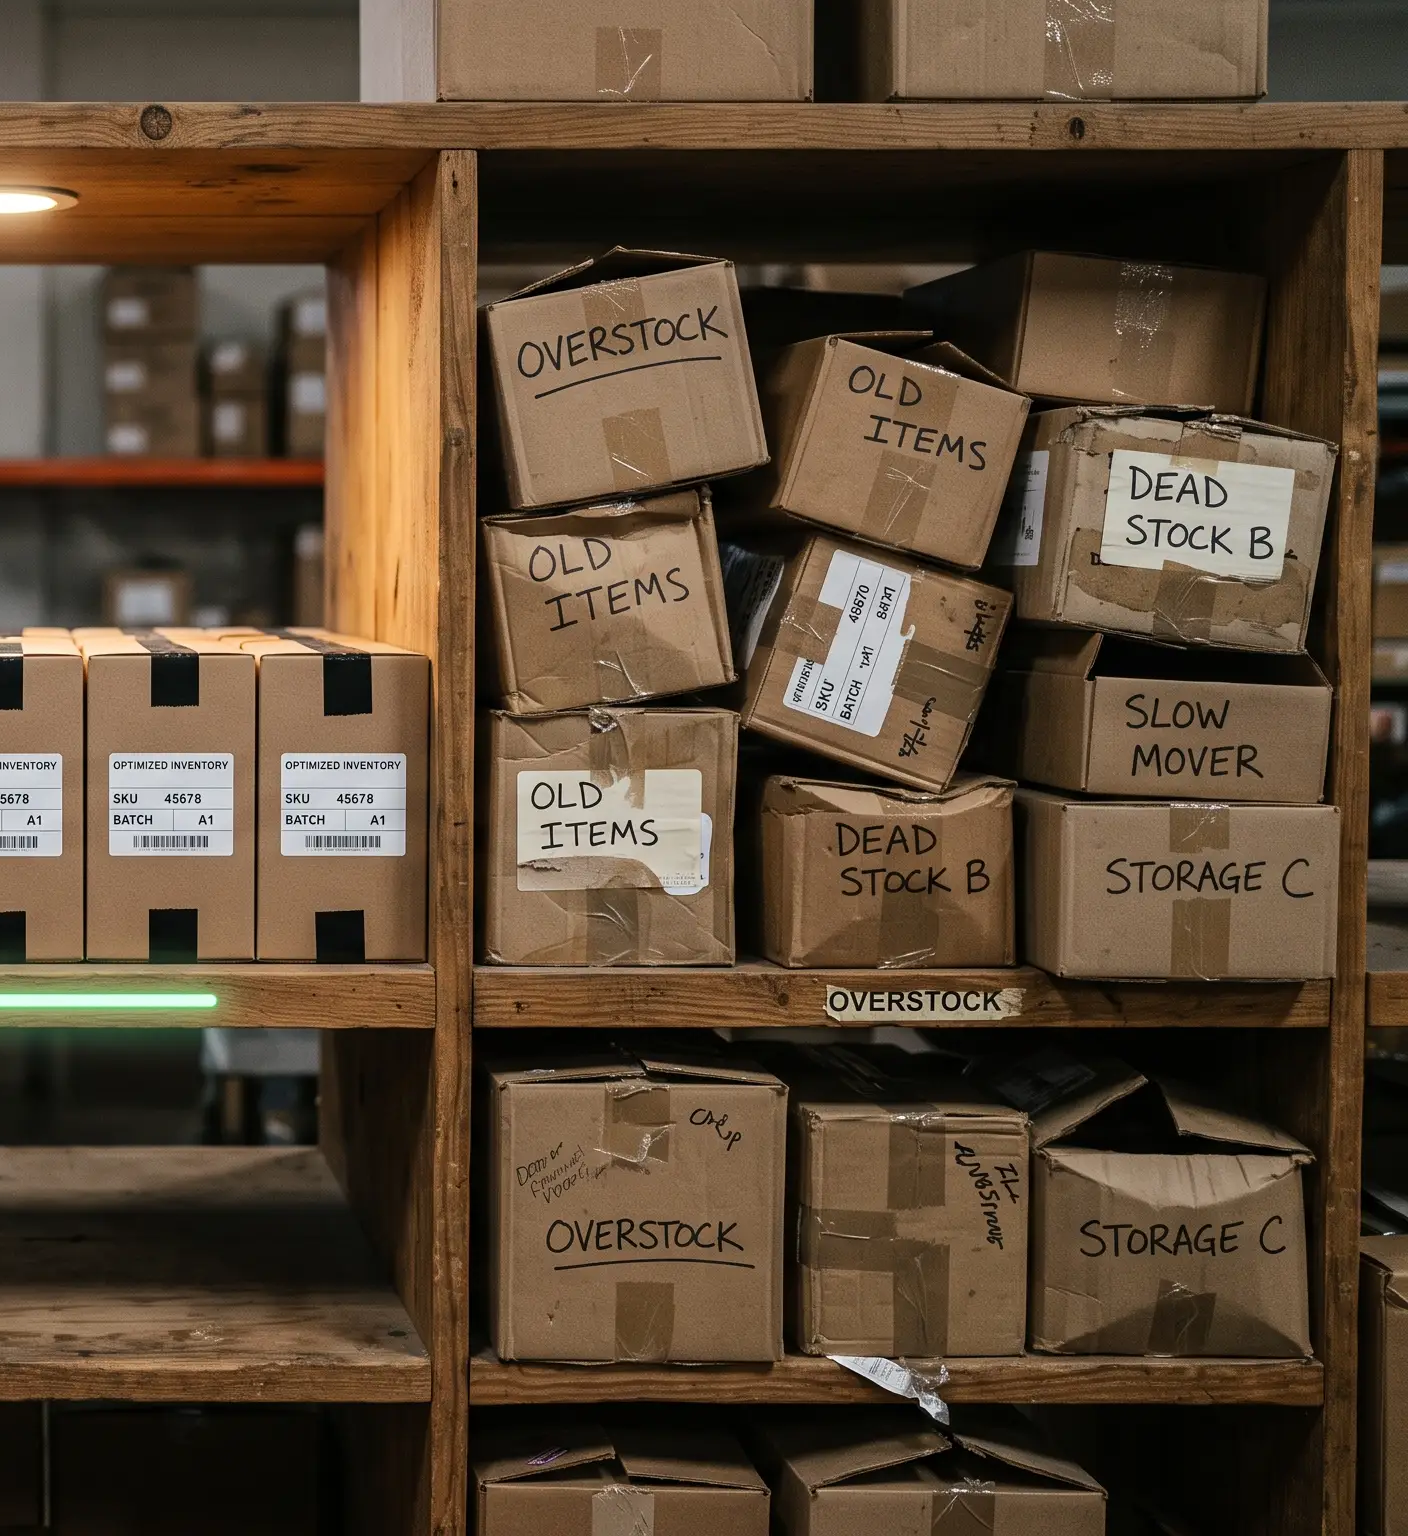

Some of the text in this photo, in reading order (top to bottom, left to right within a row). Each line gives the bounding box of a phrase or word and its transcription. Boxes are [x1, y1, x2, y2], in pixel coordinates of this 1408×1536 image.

[517, 305, 729, 379] OVERSTOCK
[848, 364, 923, 407] OLD
[863, 414, 988, 472] ITEMS
[1128, 465, 1229, 509] DEAD
[1125, 514, 1275, 561] STOCK B
[528, 537, 612, 582] OLD
[544, 567, 691, 632] ITEMS
[815, 678, 835, 712] SKU
[1125, 693, 1231, 730] SLOW
[112, 760, 229, 770] OPTIMIZED INVENTORY
[284, 760, 401, 770] OPTIMIZED INVENTORY
[1130, 743, 1265, 780] MOVER
[113, 793, 202, 804] SKU 45678
[285, 793, 374, 804] SKU 45678
[531, 781, 603, 810] OLD
[26, 815, 42, 826] A1
[113, 814, 214, 825] BATCH A1
[285, 814, 386, 825] BATCH A1
[540, 818, 660, 850] ITEMS
[834, 822, 938, 857] DEAD
[839, 857, 991, 898] STOCK B
[1105, 857, 1315, 899] STORAGE C
[827, 990, 1003, 1013] OVERSTOCK
[545, 1218, 745, 1254] OVERSTOCK
[1079, 1214, 1288, 1258] STORAGE C
